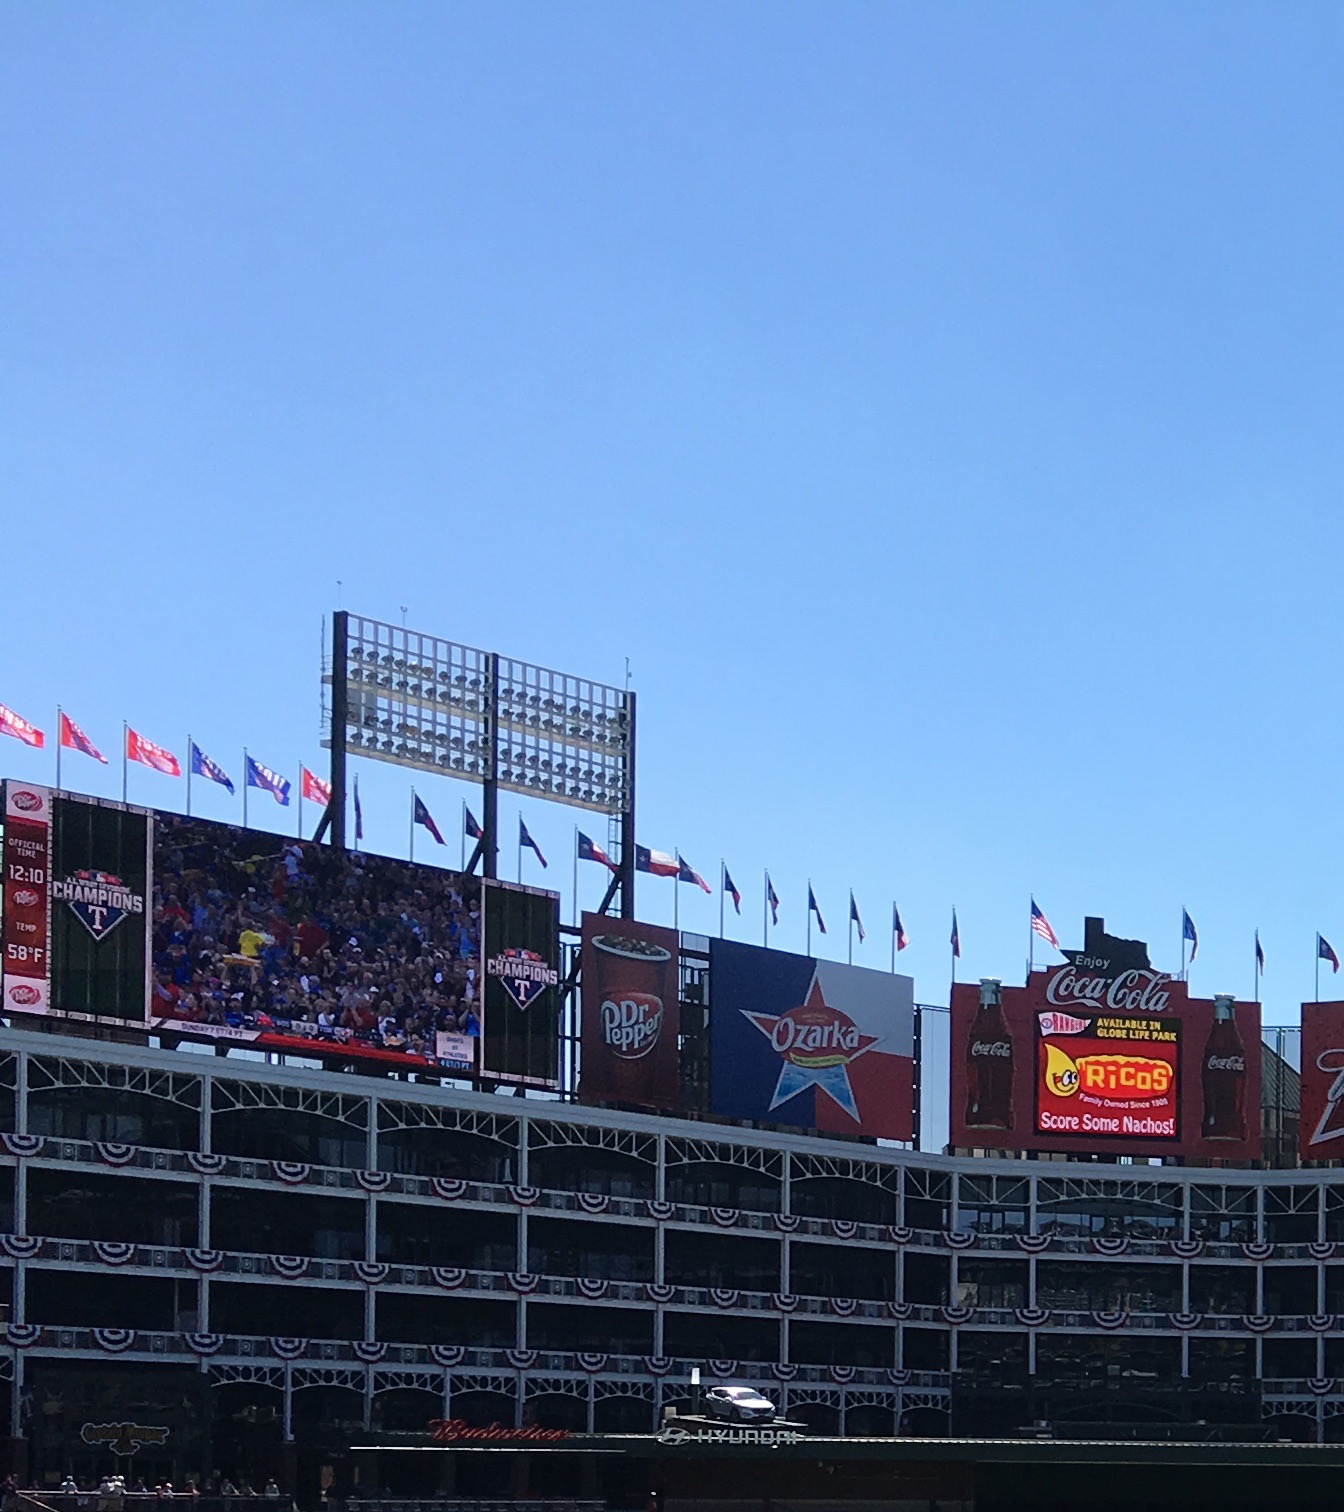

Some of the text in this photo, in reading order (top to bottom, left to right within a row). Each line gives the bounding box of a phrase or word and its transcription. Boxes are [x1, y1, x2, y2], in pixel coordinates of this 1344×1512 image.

[9, 838, 45, 853] OFFICIAL
[17, 847, 36, 859] TIME
[9, 864, 44, 884] 12:10
[53, 881, 143, 913] CHAMPIONS
[16, 920, 37, 932] TEMP
[88, 905, 107, 930] T
[487, 959, 558, 986] CHAMPIONS
[1075, 955, 1110, 973] Enjoy
[515, 979, 530, 1001] T
[601, 1000, 660, 1052] Pepper
[1096, 1018, 1161, 1031] AVAILABLE IN
[771, 1017, 860, 1052] Ozarka
[1096, 1028, 1177, 1042] GLOBE LIFE PARK
[1130, 1099, 1150, 1109] Since
[1041, 1112, 1175, 1135] Score Some Nachos!
[697, 1428, 798, 1445] HYUNDAI
